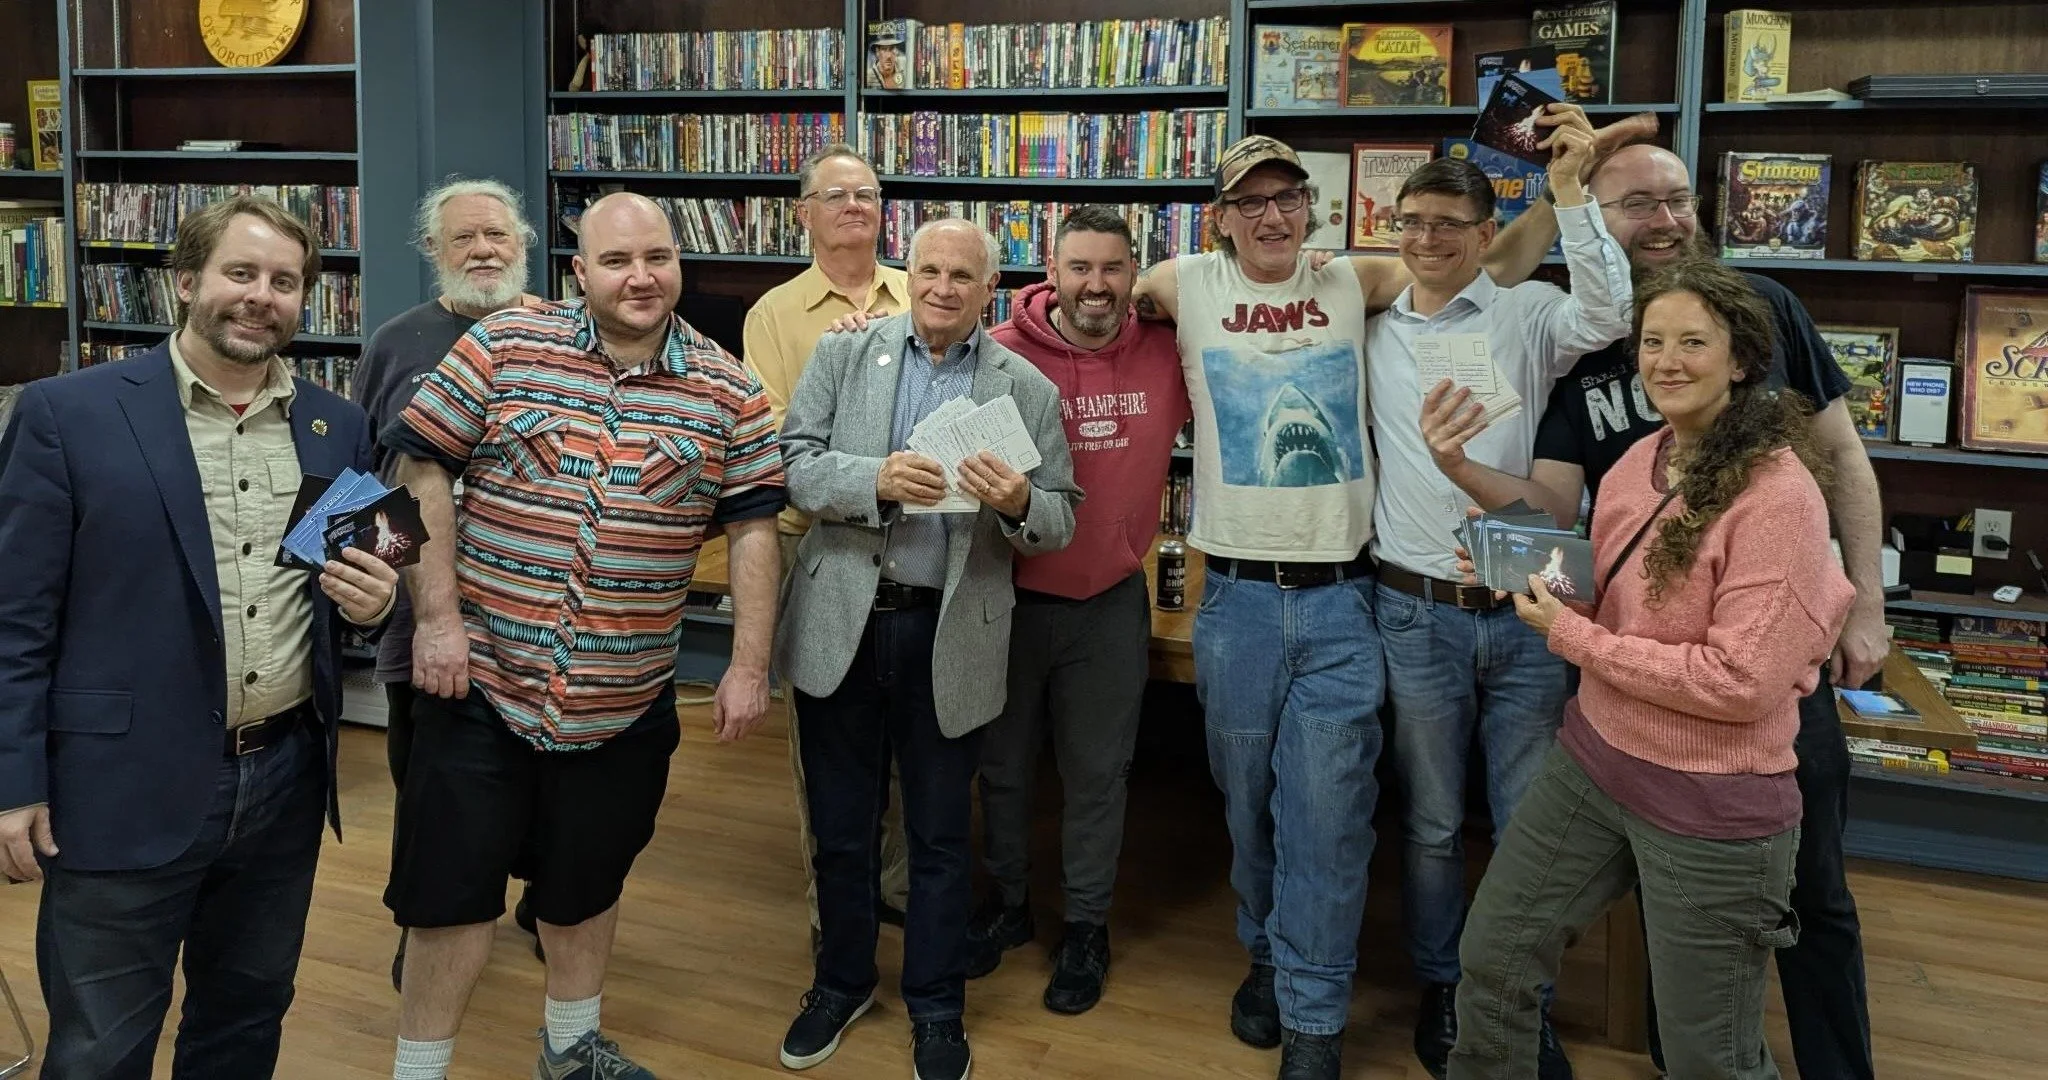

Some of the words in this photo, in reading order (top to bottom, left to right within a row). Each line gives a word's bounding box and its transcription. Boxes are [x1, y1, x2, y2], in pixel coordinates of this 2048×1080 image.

[1746, 12, 1790, 28] MUNCHKIN
[1538, 21, 1600, 39] GAMES
[202, 15, 217, 40] OF
[210, 24, 293, 66] PORCUPINES
[1376, 40, 1420, 54] CATAN
[1741, 160, 1820, 185] Stratego
[1491, 178, 1525, 199] ne
[1221, 298, 1330, 333] JAWS
[1076, 391, 1149, 419] HAMPSHIRE
[1085, 441, 1103, 452] FREE
[1103, 440, 1114, 451] OR
[1115, 437, 1130, 448] DIE
[1982, 720, 2018, 732] HANDBOOK
[1879, 743, 1899, 751] CARD
[1900, 746, 1926, 755] GAMES
